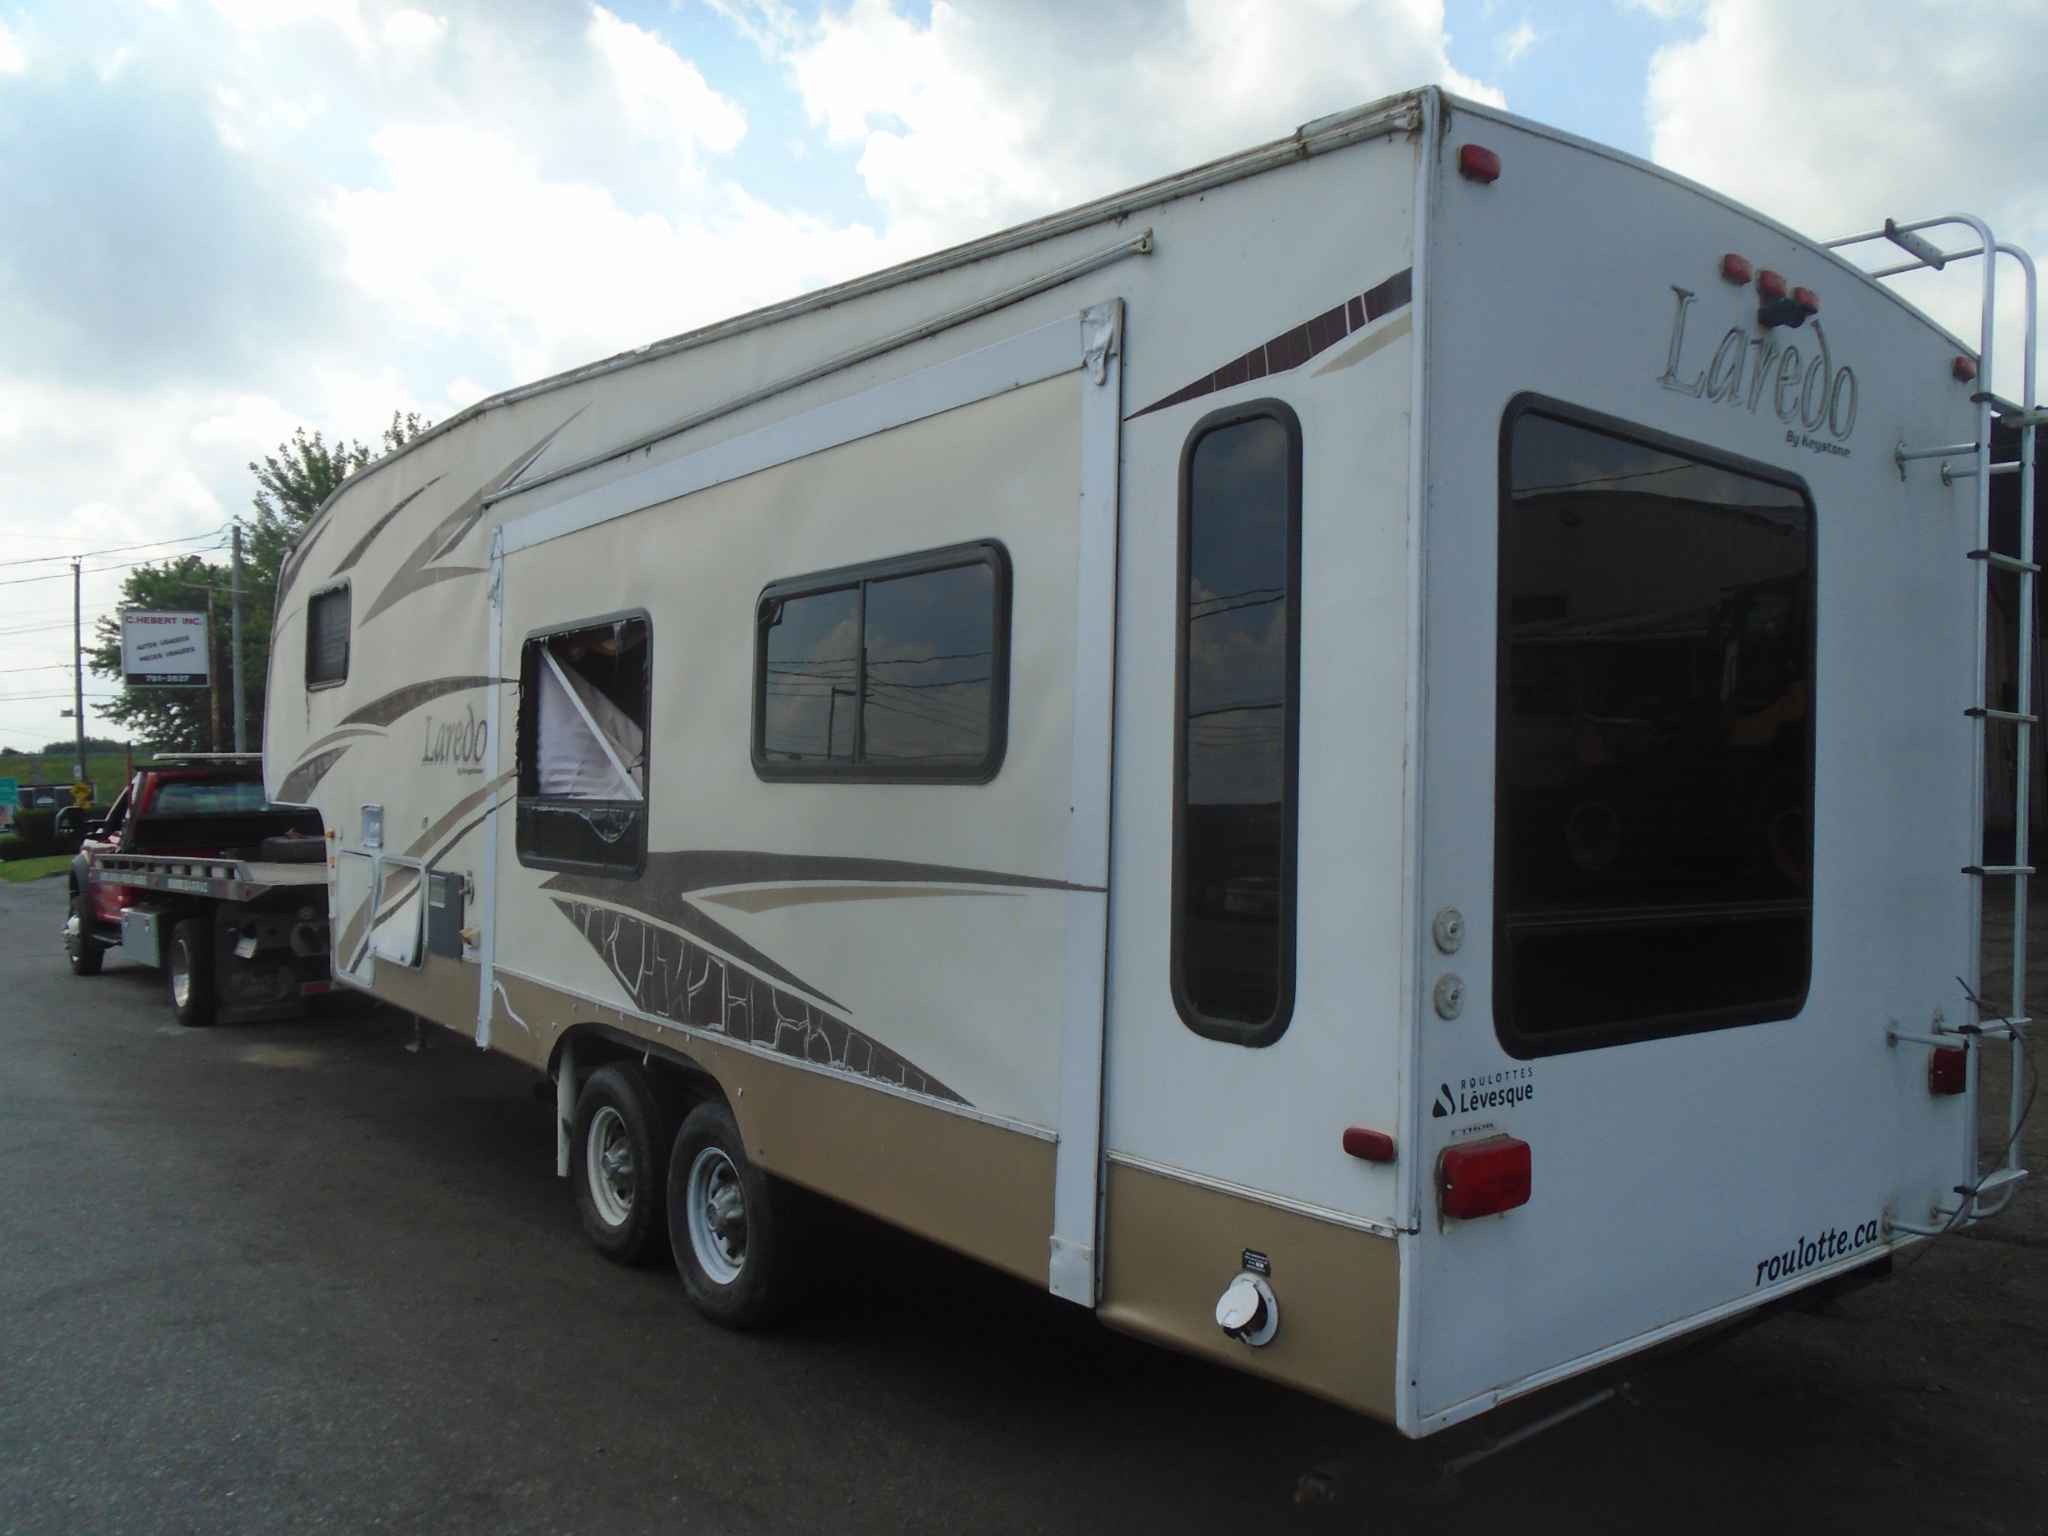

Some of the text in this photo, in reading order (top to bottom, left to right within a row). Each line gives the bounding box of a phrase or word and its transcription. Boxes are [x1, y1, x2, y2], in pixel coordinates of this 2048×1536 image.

[1656, 285, 1858, 442] Laredo
[1786, 429, 1851, 457] By Keystone
[421, 703, 488, 762] Laredo
[1460, 1066, 1534, 1090] ROULOTTES
[1460, 1084, 1534, 1113] Lévesque
[1756, 1219, 1878, 1287] roulotte.ca
